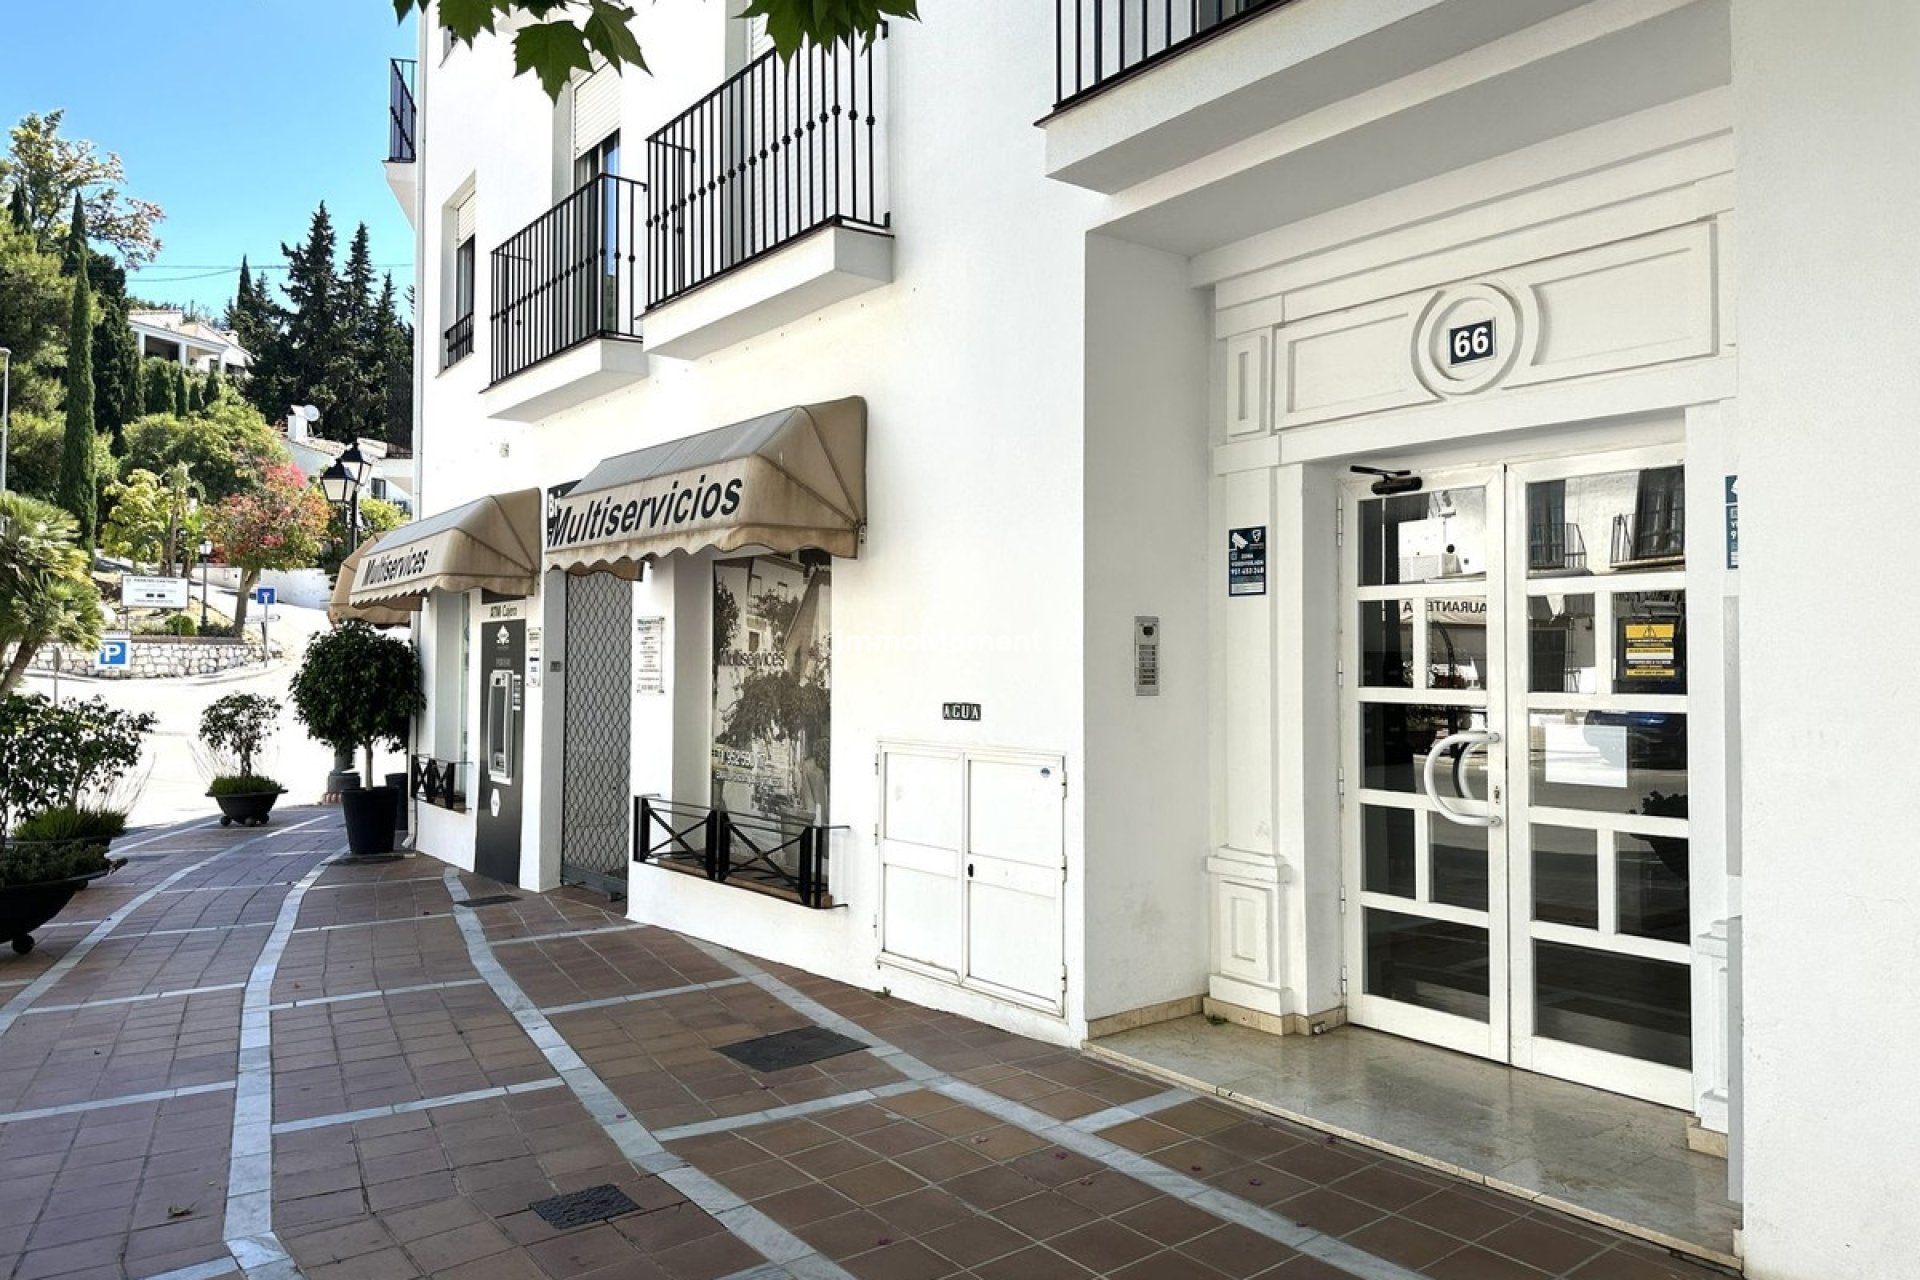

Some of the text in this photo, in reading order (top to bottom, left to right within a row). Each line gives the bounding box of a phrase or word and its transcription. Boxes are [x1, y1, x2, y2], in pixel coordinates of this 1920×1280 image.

[1454, 327, 1489, 358] 66
[552, 474, 743, 546] Multiservicios
[362, 547, 429, 586] Multiservices
[105, 644, 121, 662] P
[943, 704, 979, 719] AGUA
